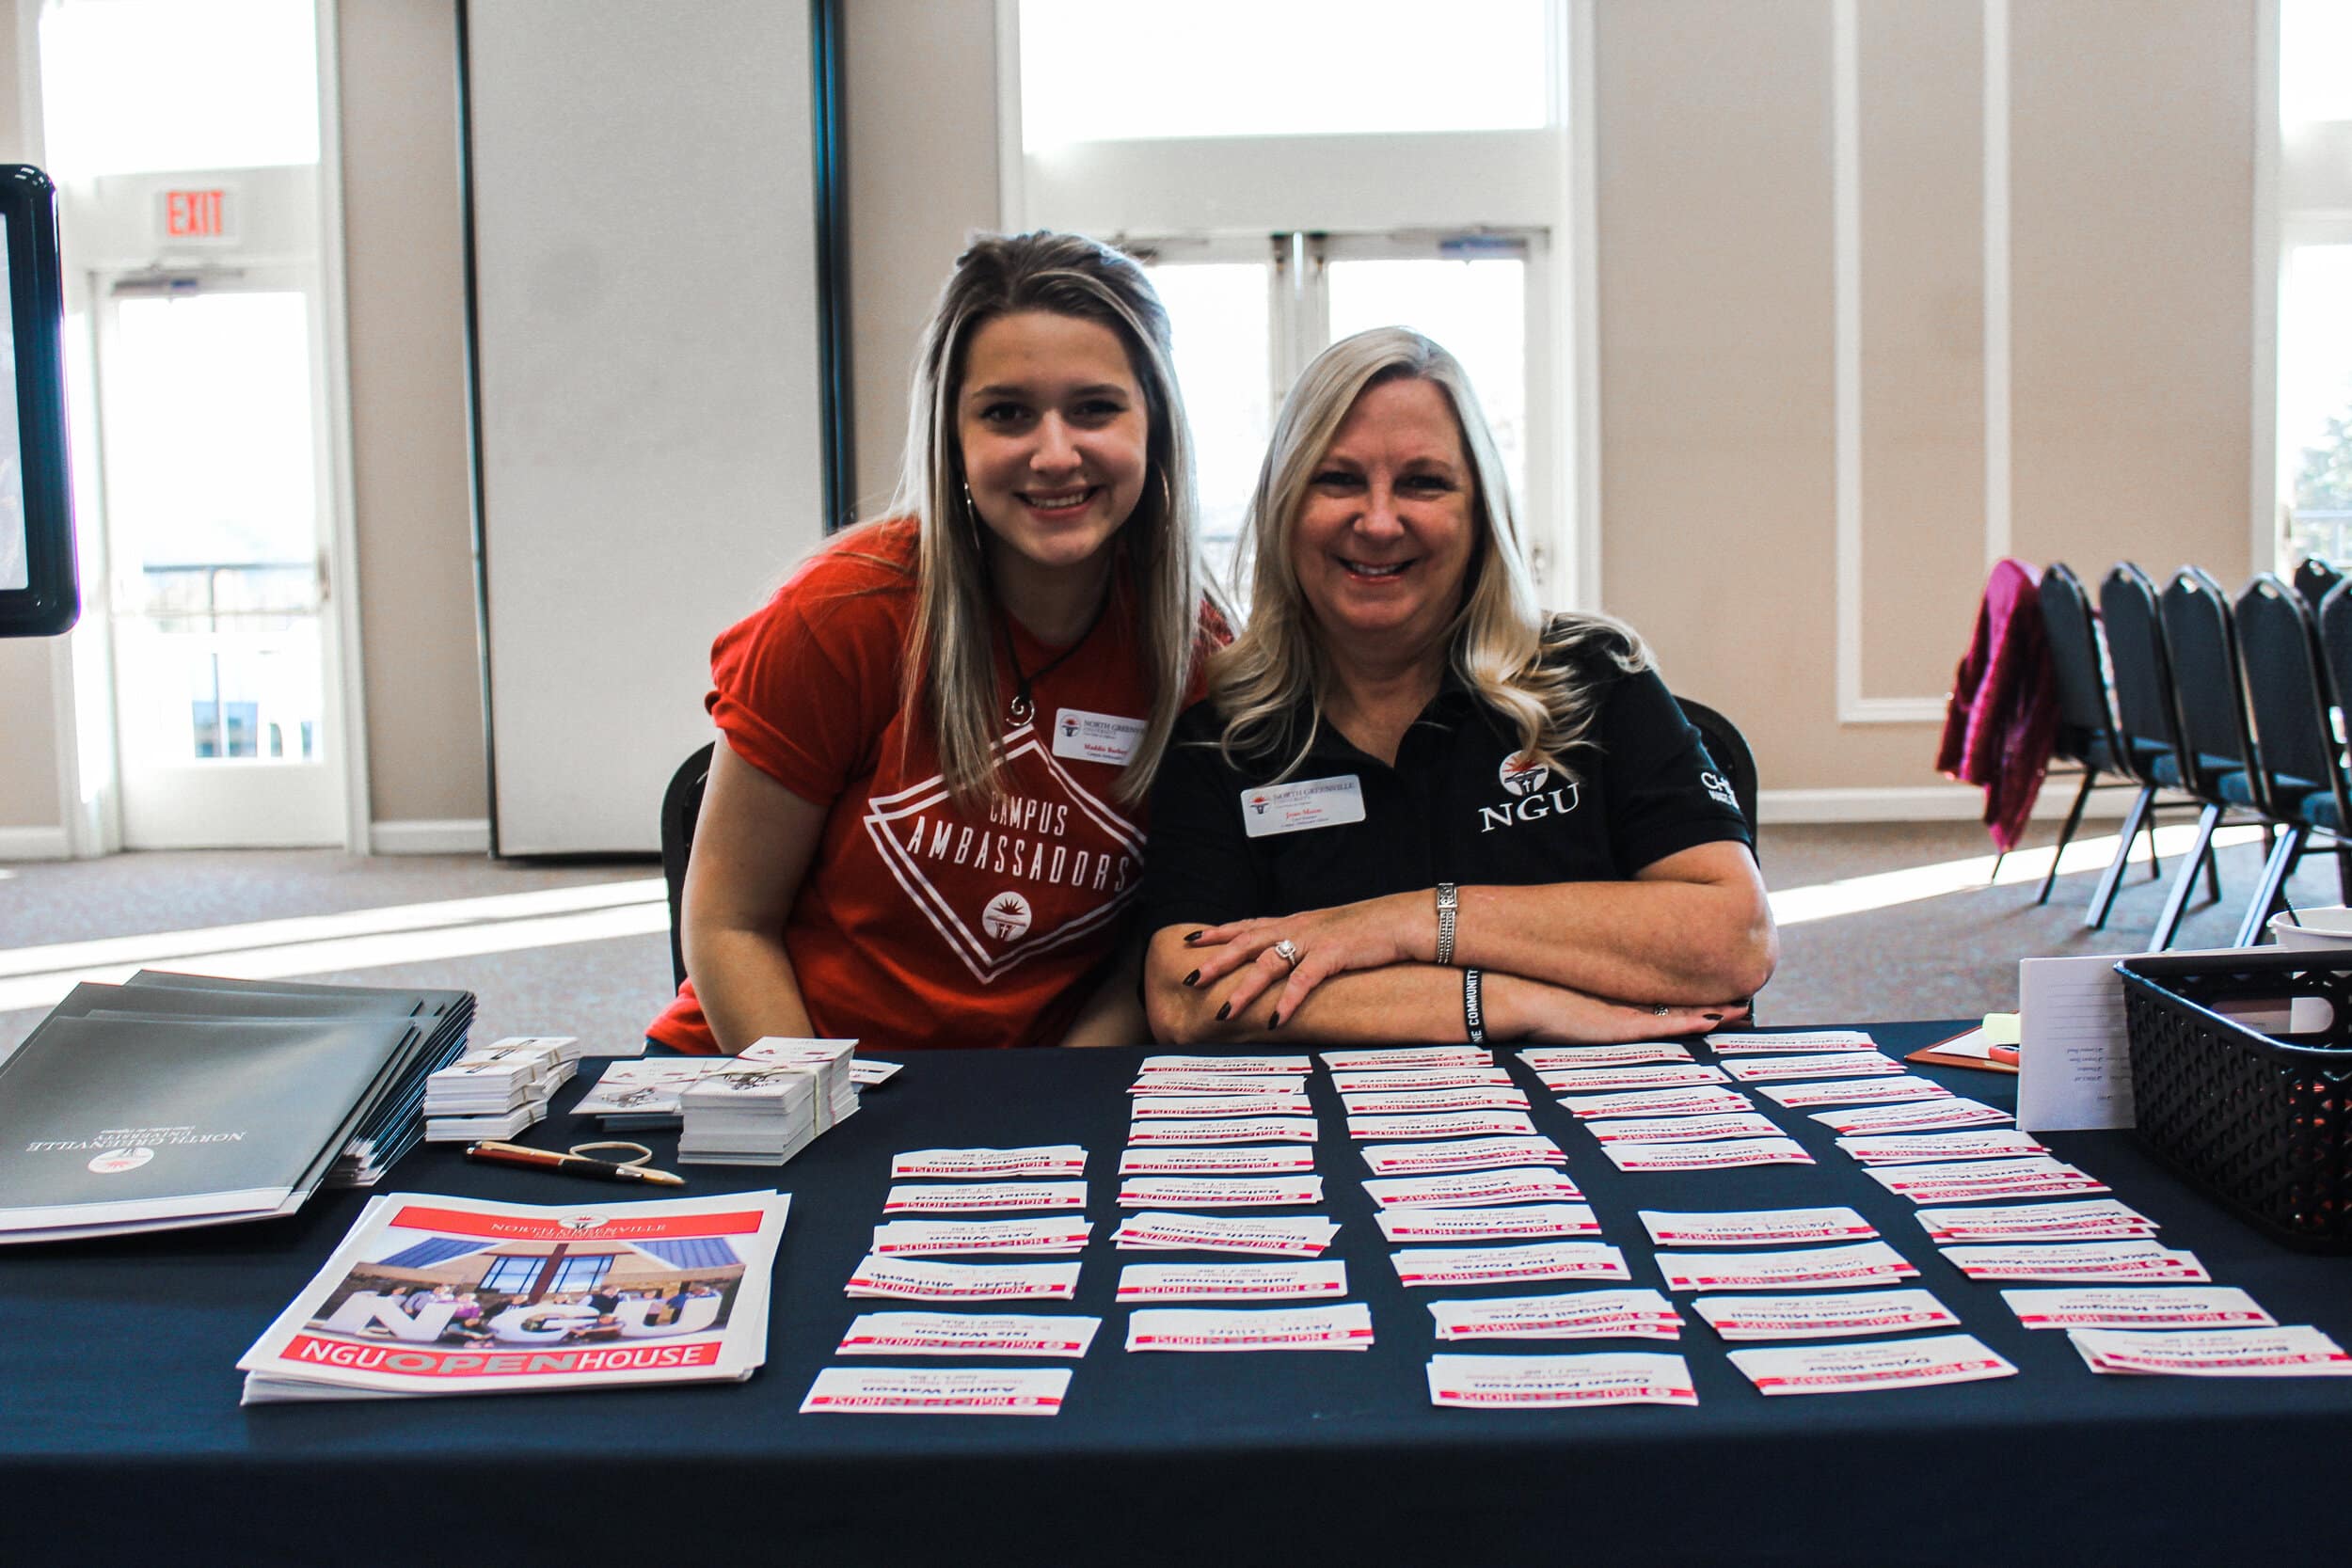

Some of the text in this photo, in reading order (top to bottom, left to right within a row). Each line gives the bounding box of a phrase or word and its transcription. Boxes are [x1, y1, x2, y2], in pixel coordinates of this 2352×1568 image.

[166, 190, 224, 237] EXIT
[991, 793, 1069, 836] CAMPUS
[1478, 782, 1580, 832] NGU
[907, 816, 1130, 894] AMBASSADORS
[1466, 970, 1480, 1026] COMMUNITY
[25, 1132, 246, 1152] NORTH GREENVILLE
[490, 1223, 552, 1236] NORTH
